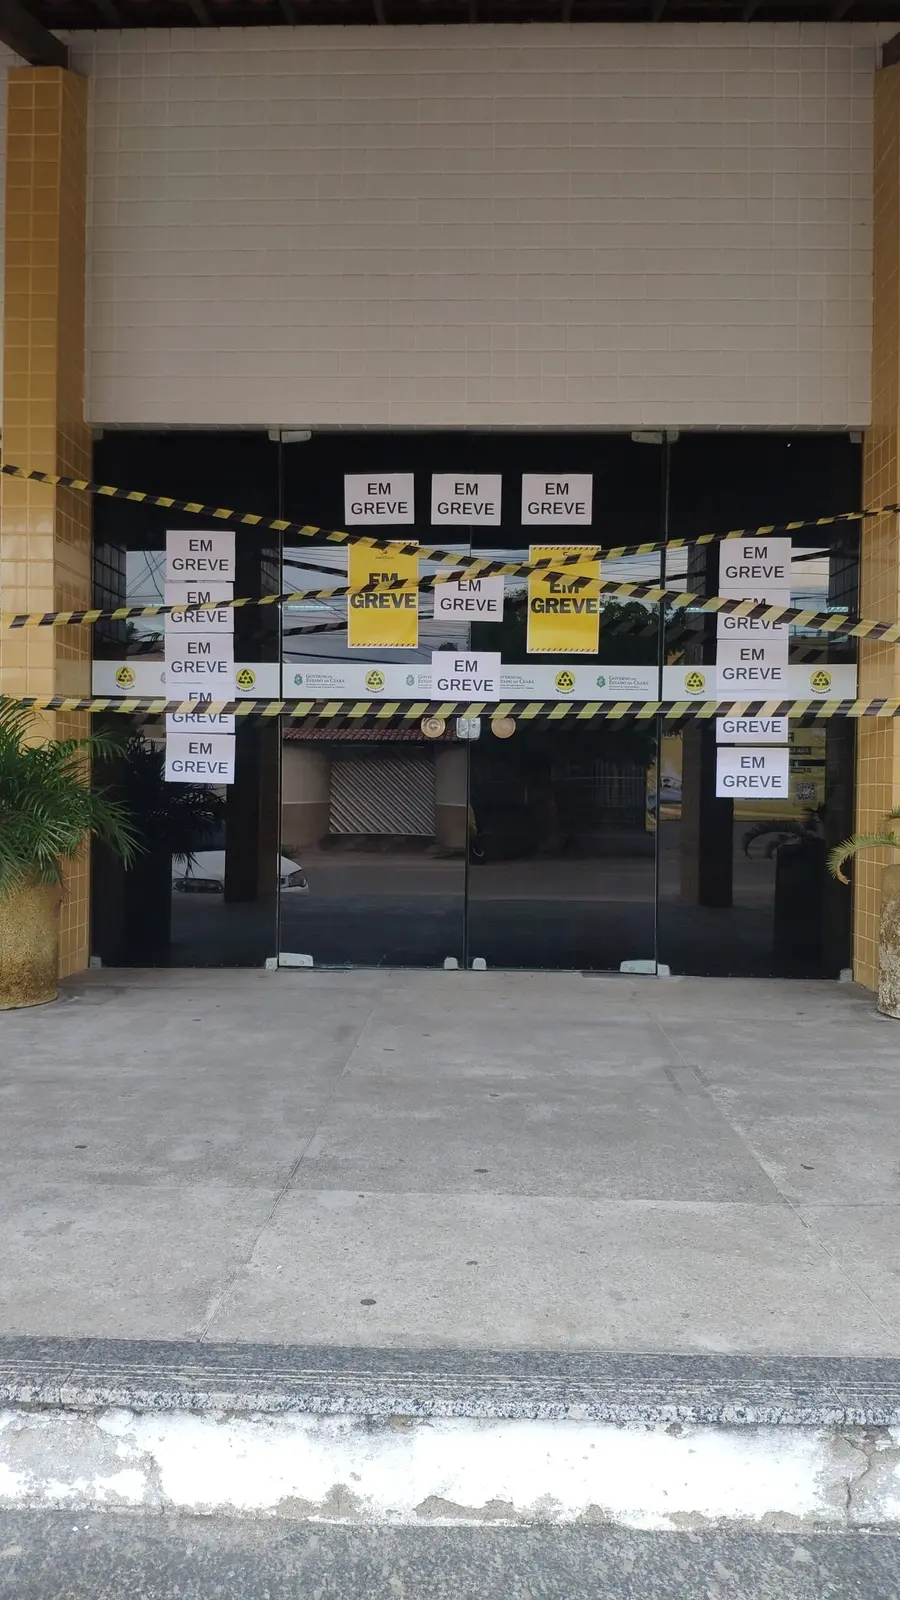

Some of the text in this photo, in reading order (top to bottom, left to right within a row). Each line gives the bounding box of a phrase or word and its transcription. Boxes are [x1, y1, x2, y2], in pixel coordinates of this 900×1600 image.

[367, 482, 391, 495] EM
[454, 482, 479, 495] EM
[545, 482, 569, 495] EM
[350, 501, 408, 515] GREVE
[437, 502, 495, 515] GREVE
[527, 502, 586, 515] GREVE
[189, 539, 213, 552] EM
[743, 546, 768, 559] EM
[172, 558, 229, 571] GREVE
[726, 566, 784, 579] GREVE
[457, 580, 481, 592] EM
[187, 592, 211, 604] EM
[350, 592, 417, 609] GREVE
[440, 598, 497, 612] GREVE
[531, 598, 598, 614] GREVE
[171, 611, 228, 623] GREVE
[187, 642, 211, 654] EM
[740, 648, 765, 661] EM
[171, 660, 228, 673] GREVE
[454, 660, 478, 672] EM
[722, 667, 782, 680] GREVE
[437, 678, 494, 692] GREVE
[722, 720, 782, 733] GREVE
[189, 742, 212, 754] EM
[171, 760, 228, 774] GREVE
[740, 756, 765, 769] EM
[722, 775, 782, 788] GREVE
